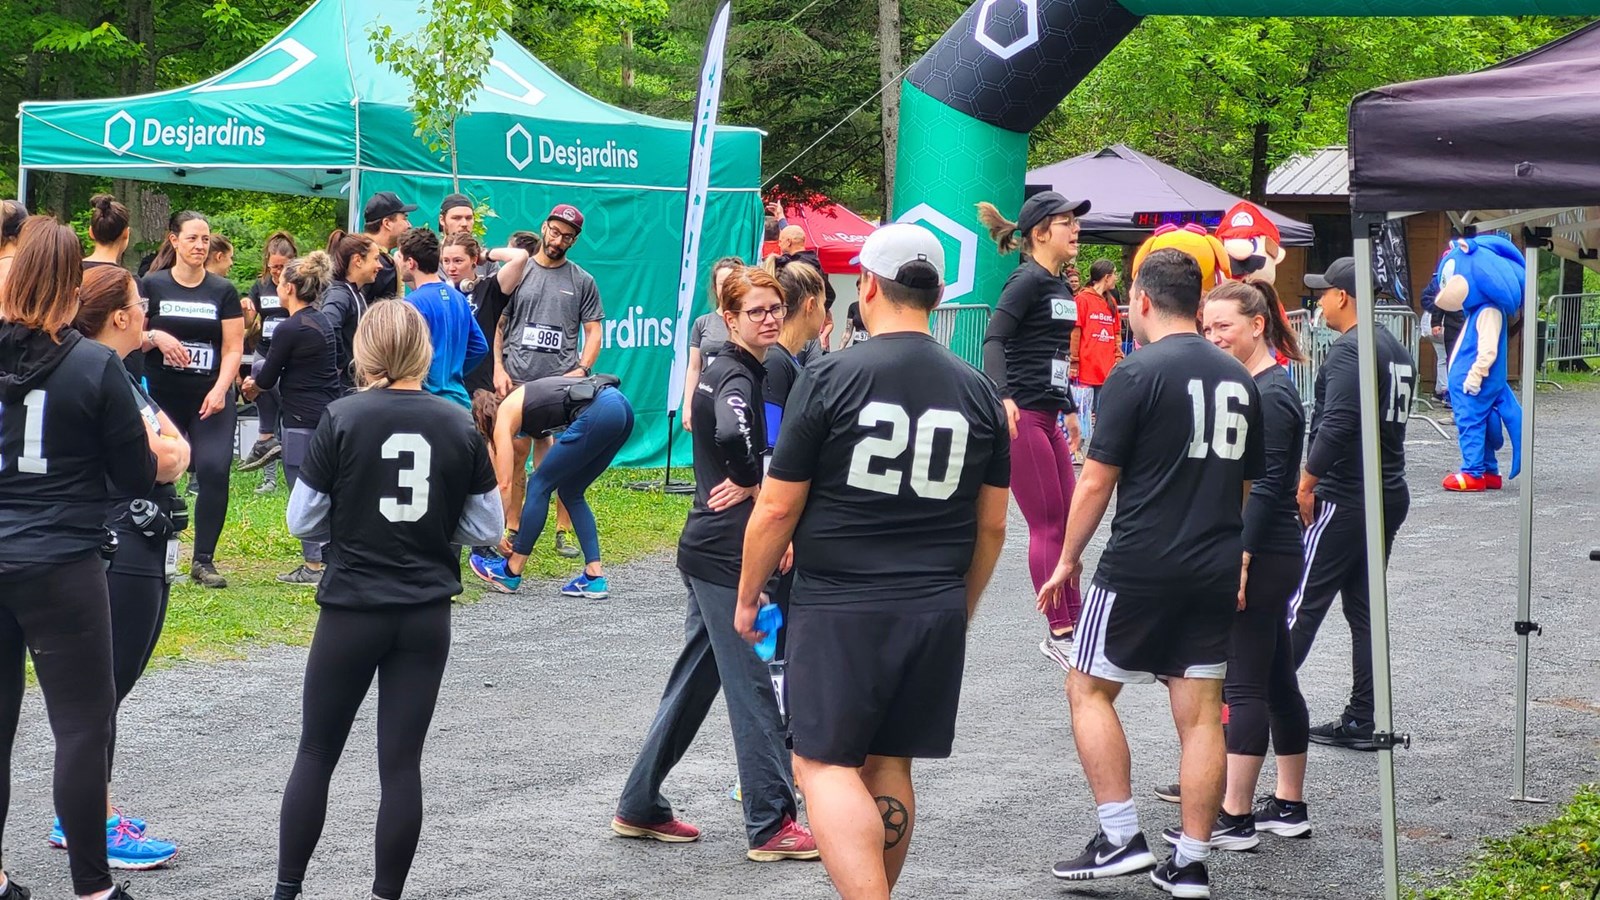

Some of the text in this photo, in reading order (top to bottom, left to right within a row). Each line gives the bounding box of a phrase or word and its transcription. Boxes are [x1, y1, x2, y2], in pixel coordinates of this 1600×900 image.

[142, 117, 266, 152] Desjardins
[538, 138, 639, 173] Desjardins
[174, 304, 215, 314] Desjardins
[601, 305, 673, 349] rdins
[537, 330, 560, 347] 986
[1385, 361, 1414, 424] 15
[0, 389, 48, 475] 1
[1186, 379, 1250, 460] 16
[846, 401, 969, 500] 20
[379, 432, 432, 523] 3
